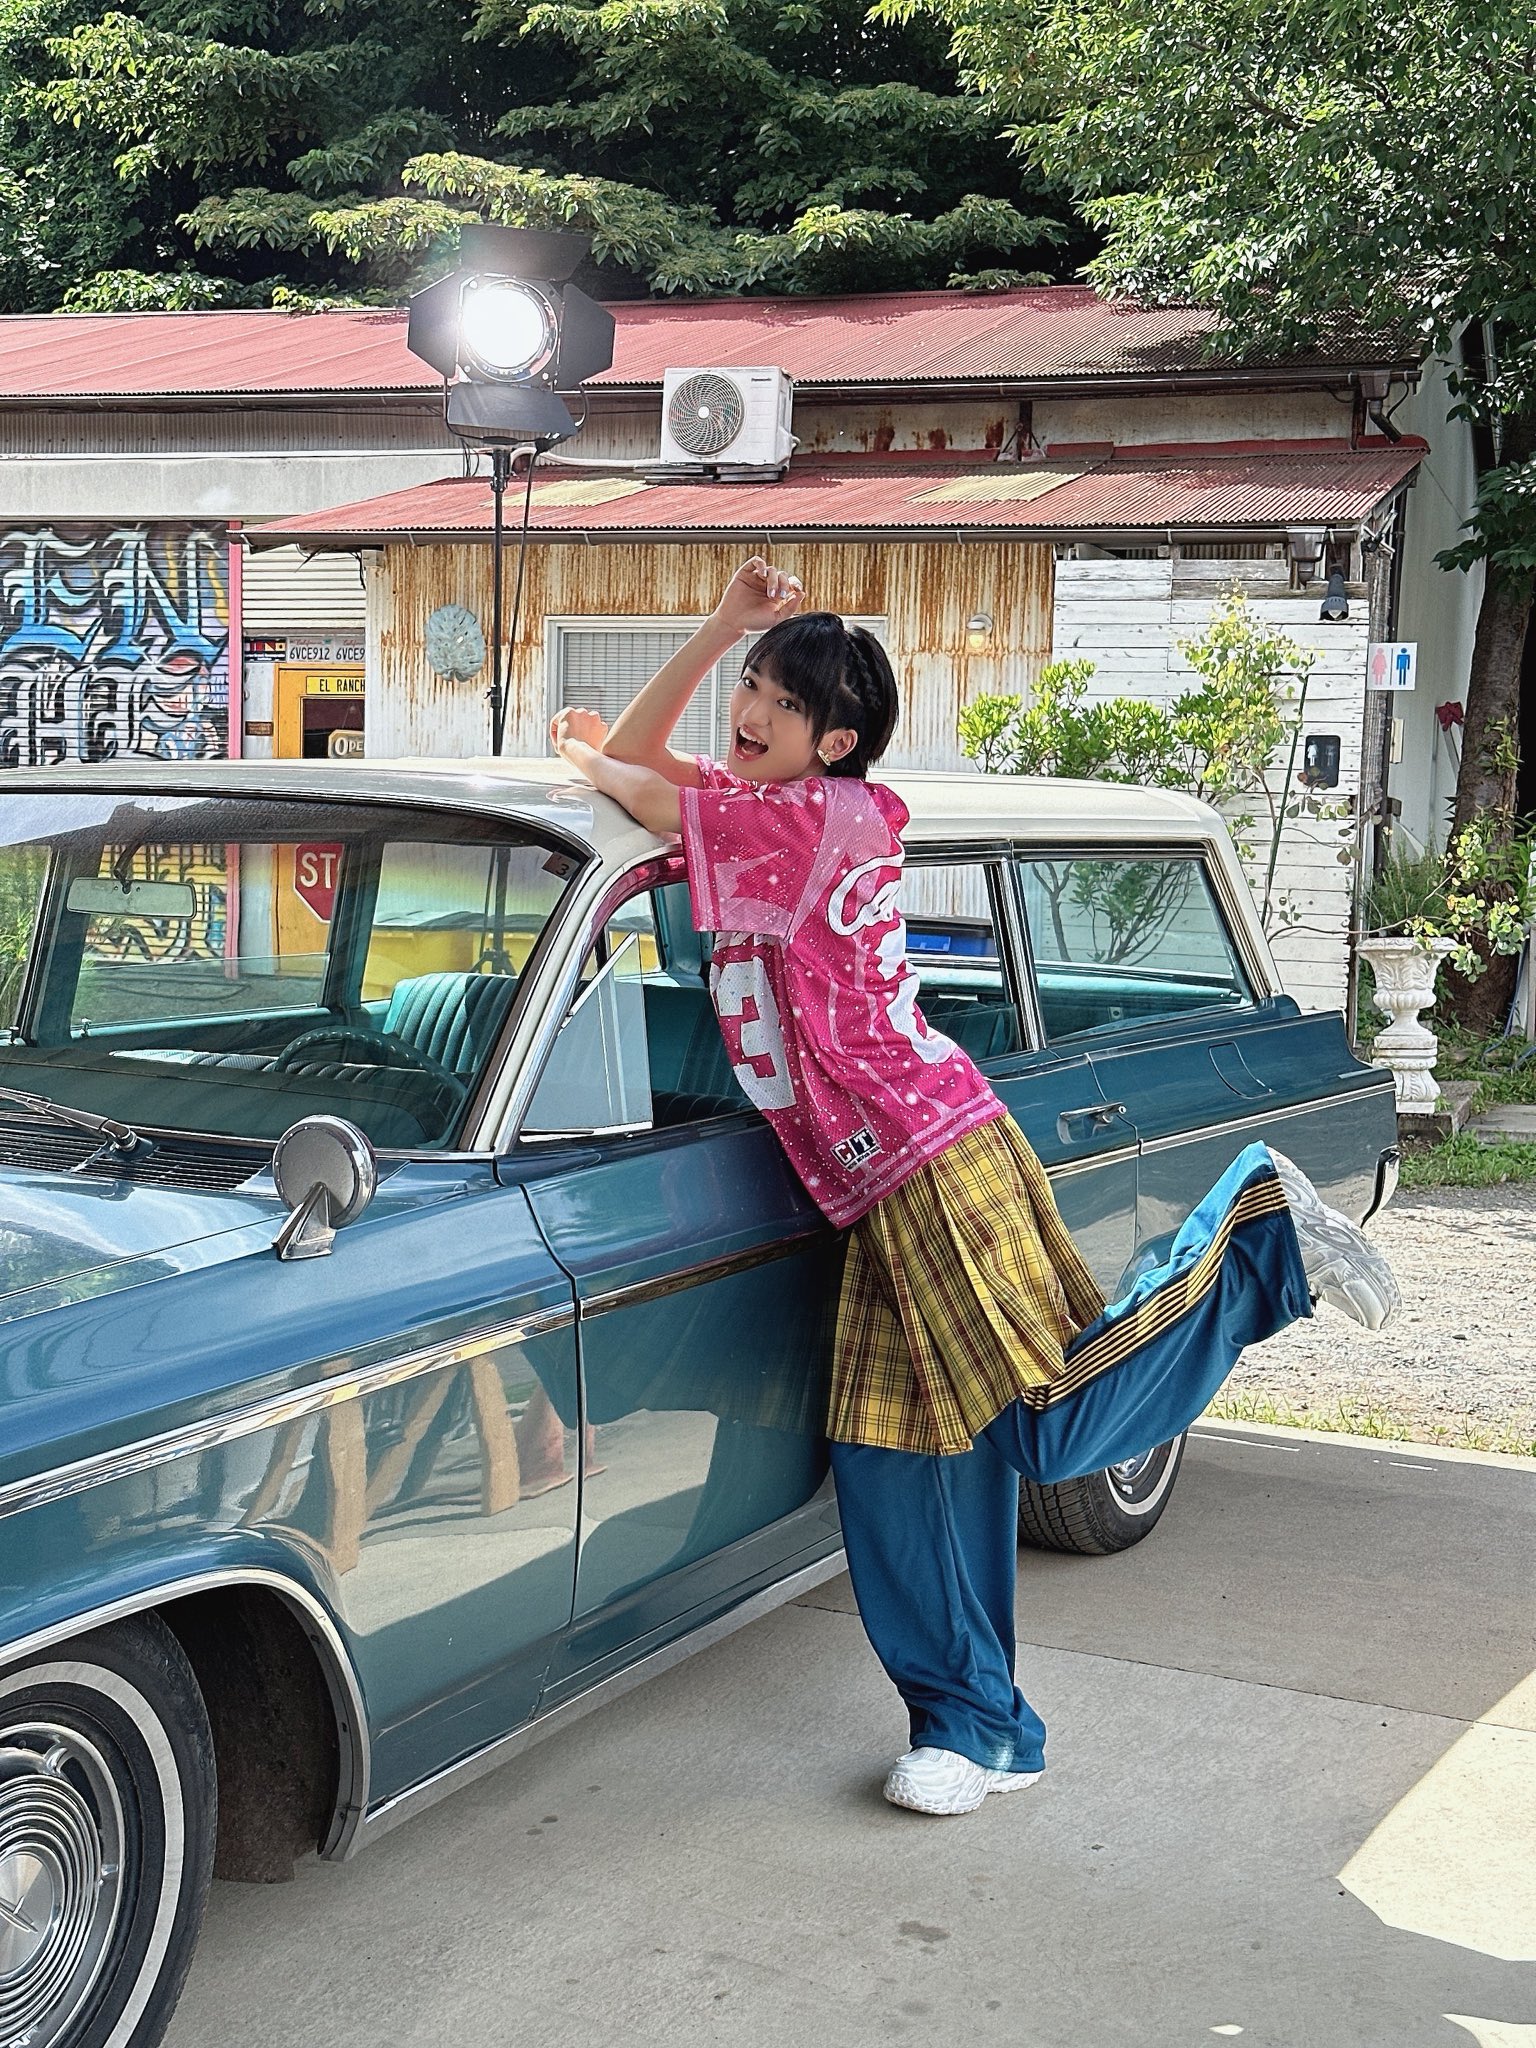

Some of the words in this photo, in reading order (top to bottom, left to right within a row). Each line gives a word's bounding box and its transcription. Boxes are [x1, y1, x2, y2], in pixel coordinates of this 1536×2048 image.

[289, 646, 330, 660] 6VCE912
[319, 678, 331, 692] EL
[300, 852, 337, 889] ST
